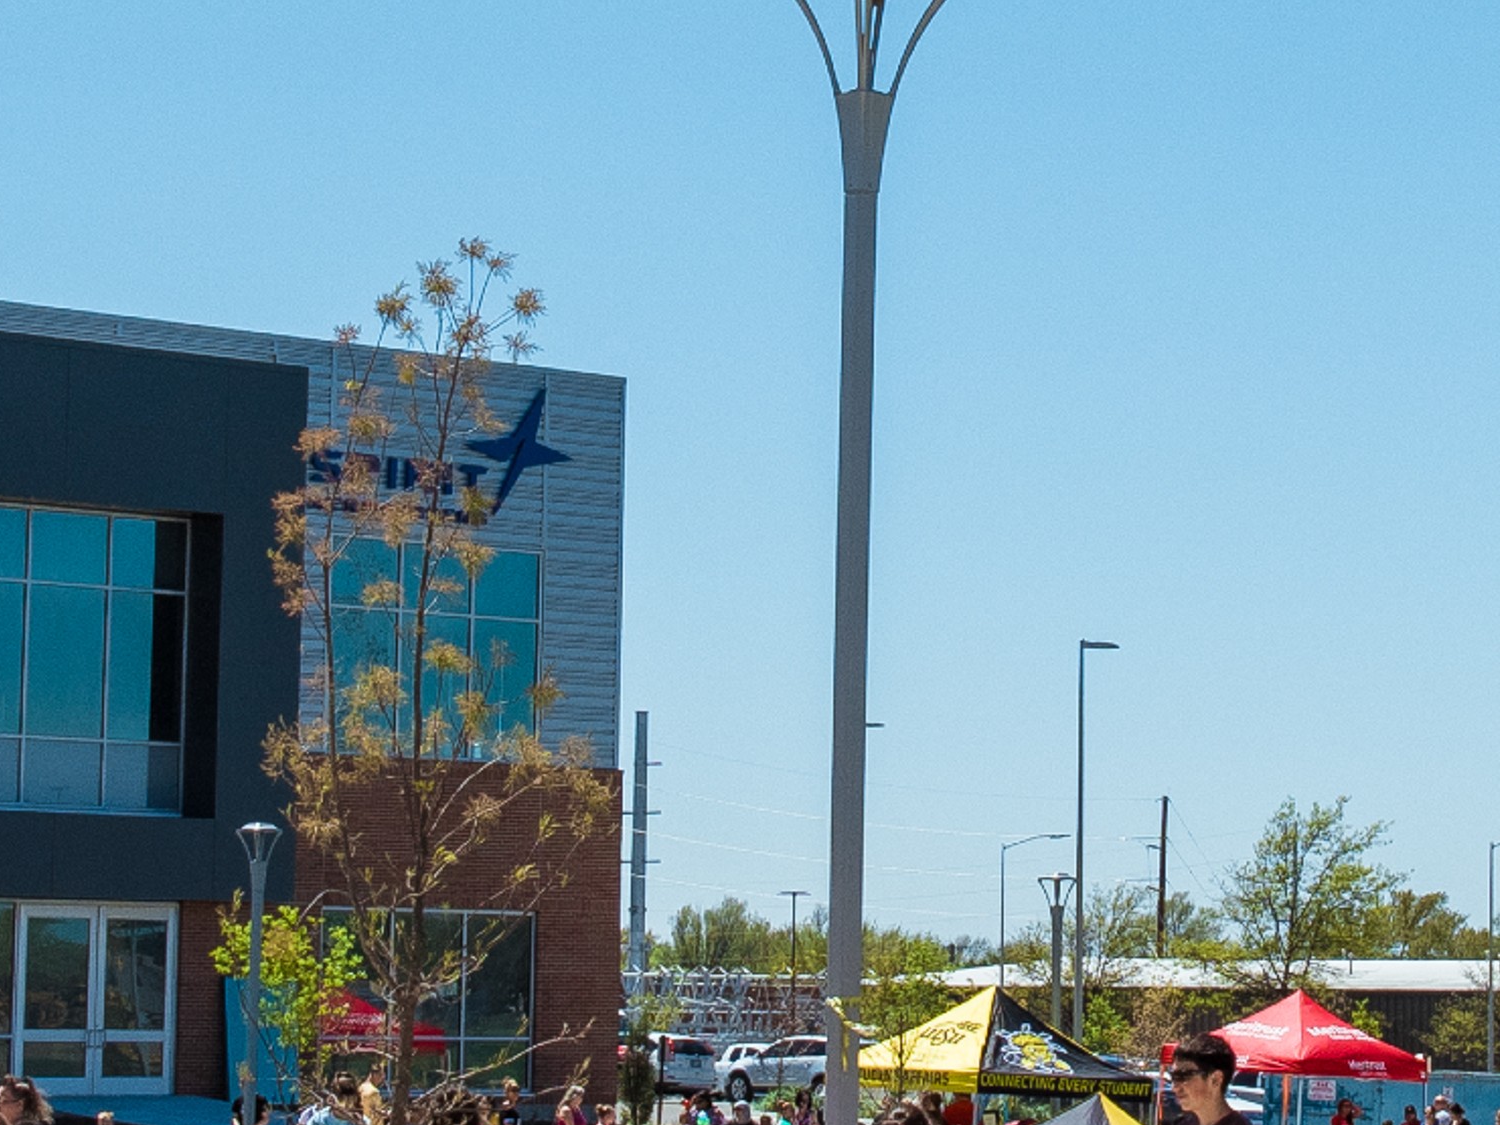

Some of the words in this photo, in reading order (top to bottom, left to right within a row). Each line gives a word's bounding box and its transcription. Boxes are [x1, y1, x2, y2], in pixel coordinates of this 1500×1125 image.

[980, 1073, 1056, 1091] CONNECTING
[1058, 1078, 1097, 1093] EVERY
[1098, 1081, 1151, 1096] STUDENT
